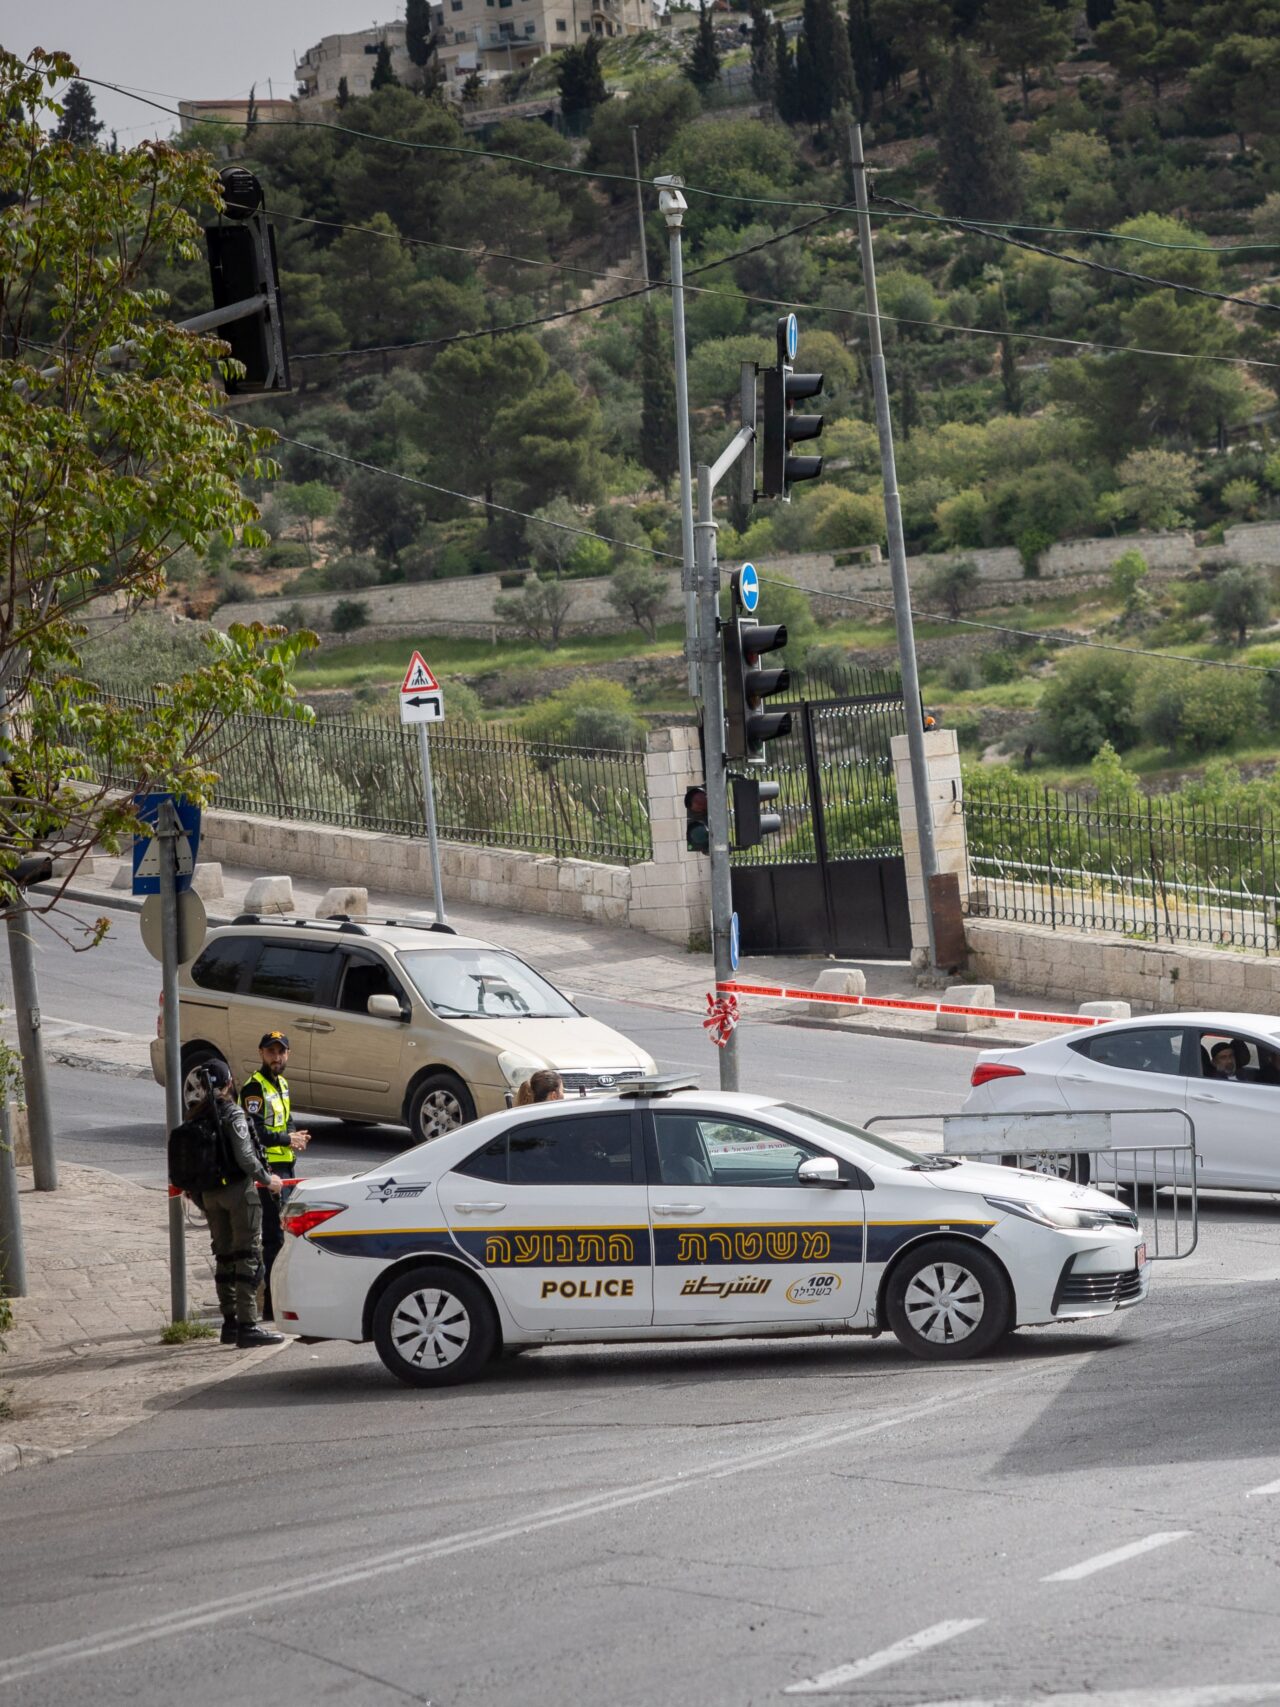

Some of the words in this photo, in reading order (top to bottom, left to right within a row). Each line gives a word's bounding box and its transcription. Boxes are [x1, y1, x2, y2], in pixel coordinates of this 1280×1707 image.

[485, 1233, 635, 1263] התנועה
[678, 1231, 831, 1261] משטרת
[541, 1279, 634, 1298] POLICE
[680, 1275, 773, 1298] الشرطة
[808, 1276, 835, 1287] 100
[793, 1287, 832, 1298] בשבילך
